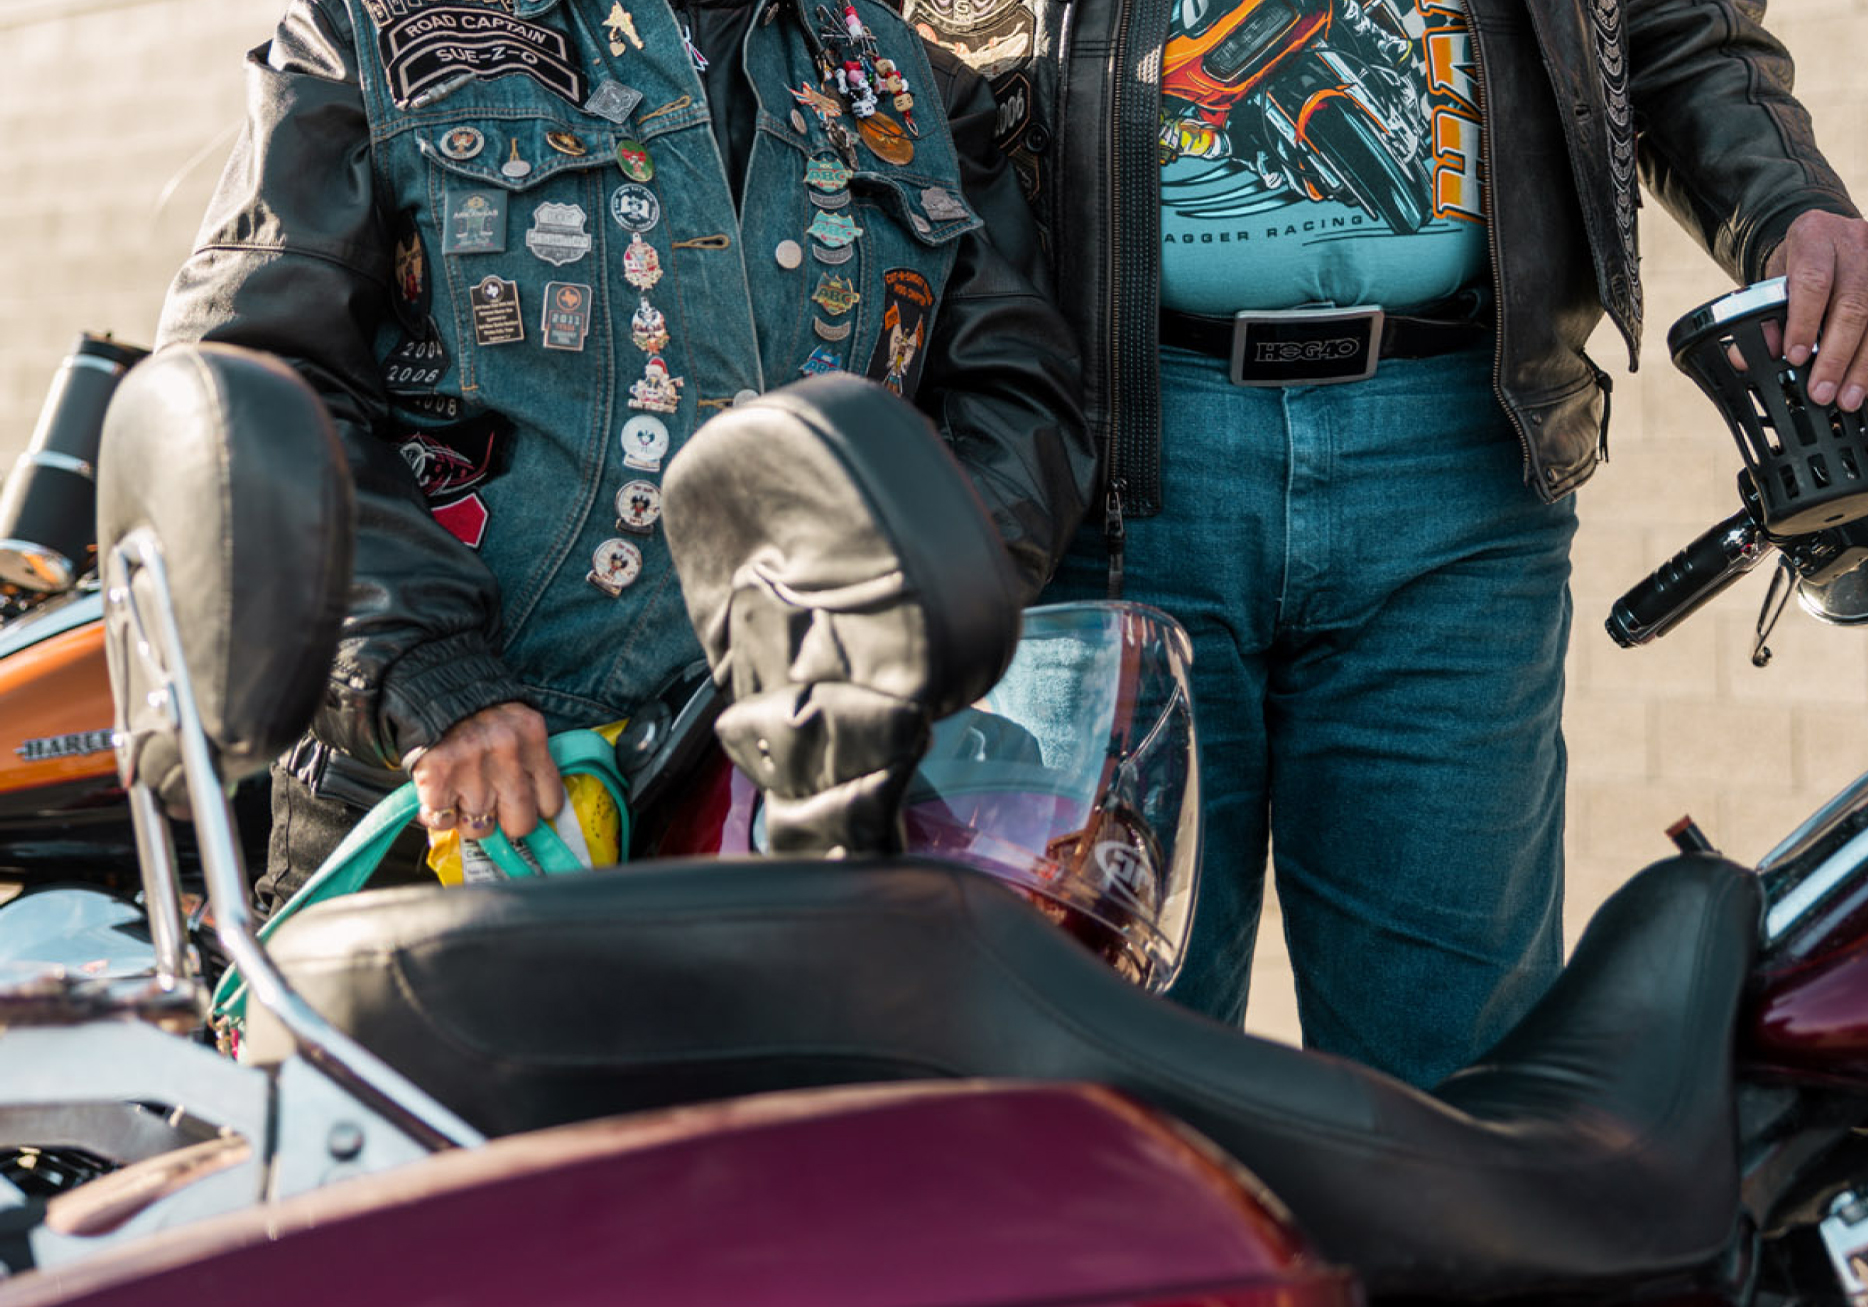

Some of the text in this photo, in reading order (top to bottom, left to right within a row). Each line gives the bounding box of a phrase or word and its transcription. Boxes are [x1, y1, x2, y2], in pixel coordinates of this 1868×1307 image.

[404, 14, 547, 44] ROAD CAPTAIN
[994, 87, 1026, 138] 006
[1164, 215, 1363, 243] AGGER RACING
[387, 365, 439, 384] 2006
[415, 396, 457, 417] 008
[26, 730, 113, 760] HARLE
